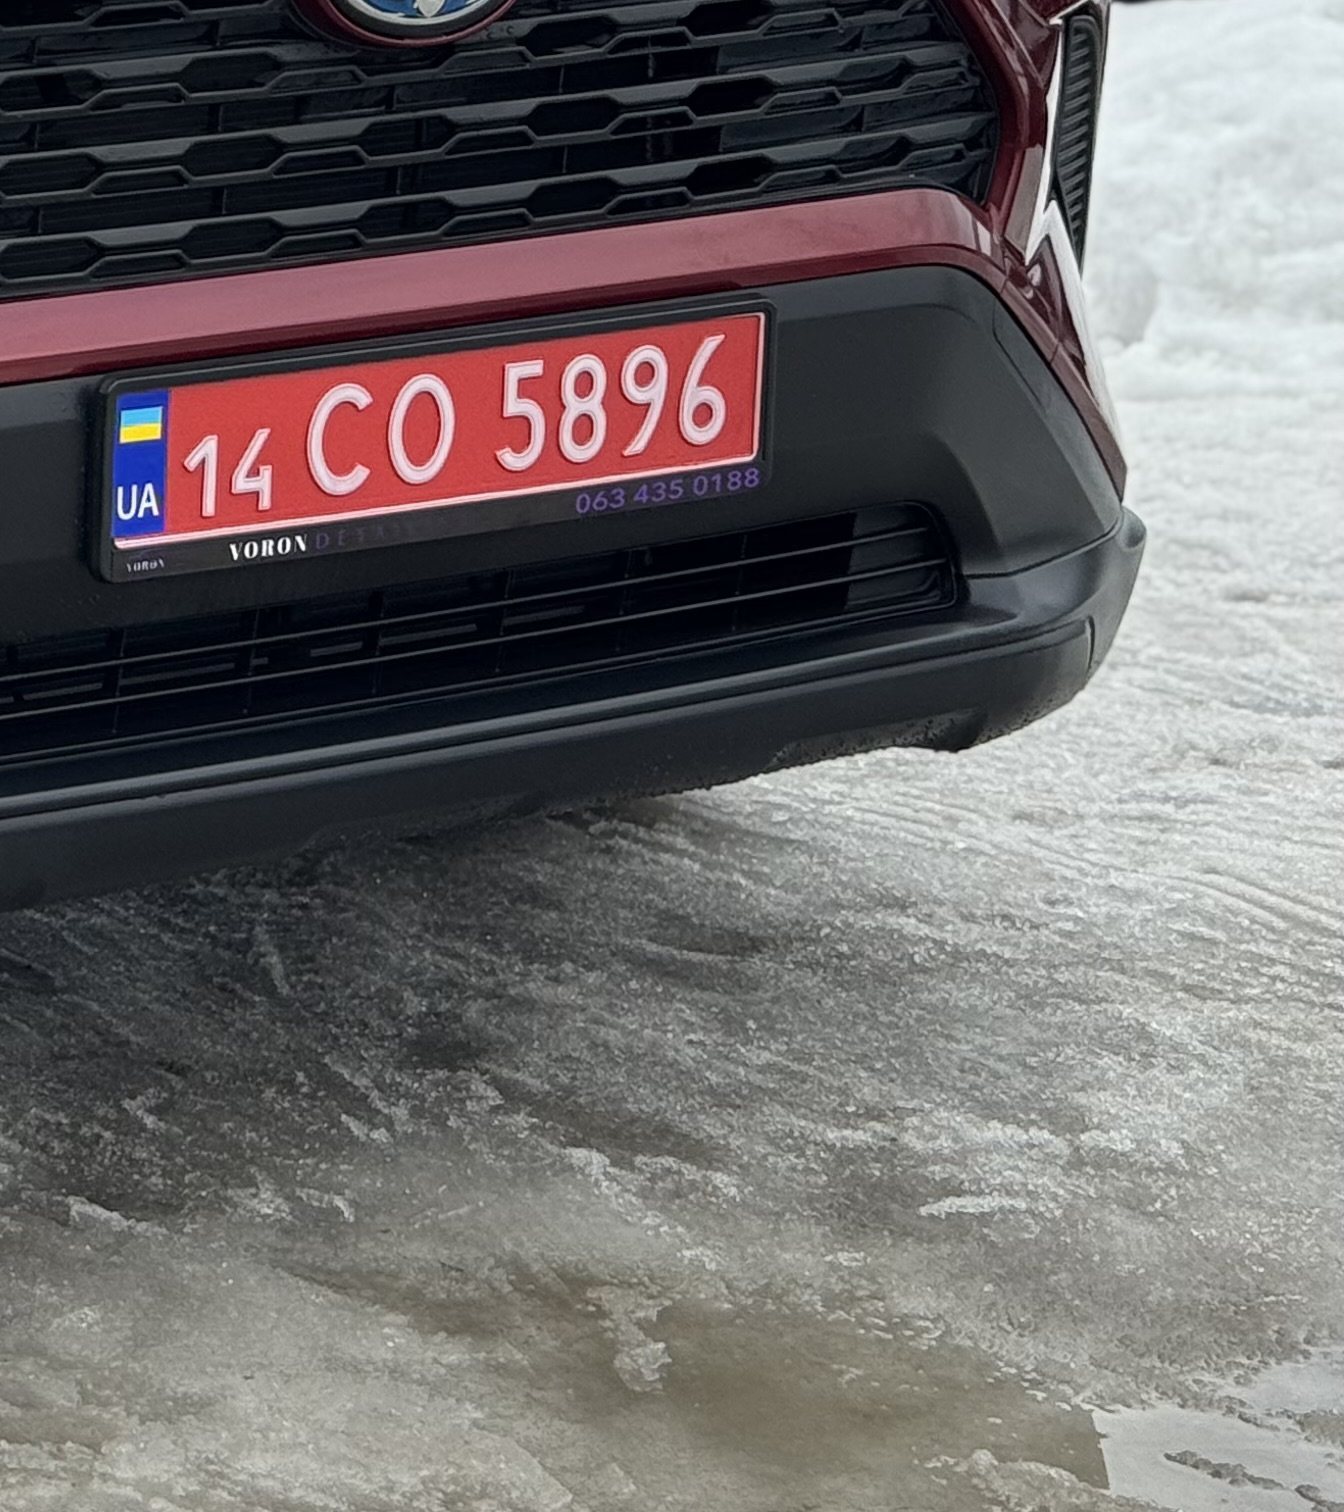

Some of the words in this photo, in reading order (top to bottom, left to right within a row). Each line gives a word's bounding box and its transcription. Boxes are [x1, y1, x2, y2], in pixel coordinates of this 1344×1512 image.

[183, 427, 273, 518] 14
[306, 373, 456, 497] CO
[495, 333, 728, 472] 5896
[116, 481, 160, 521] UA
[575, 487, 626, 514] 063
[633, 478, 684, 505] 435
[693, 467, 760, 496] 0188
[228, 533, 309, 562] VORON
